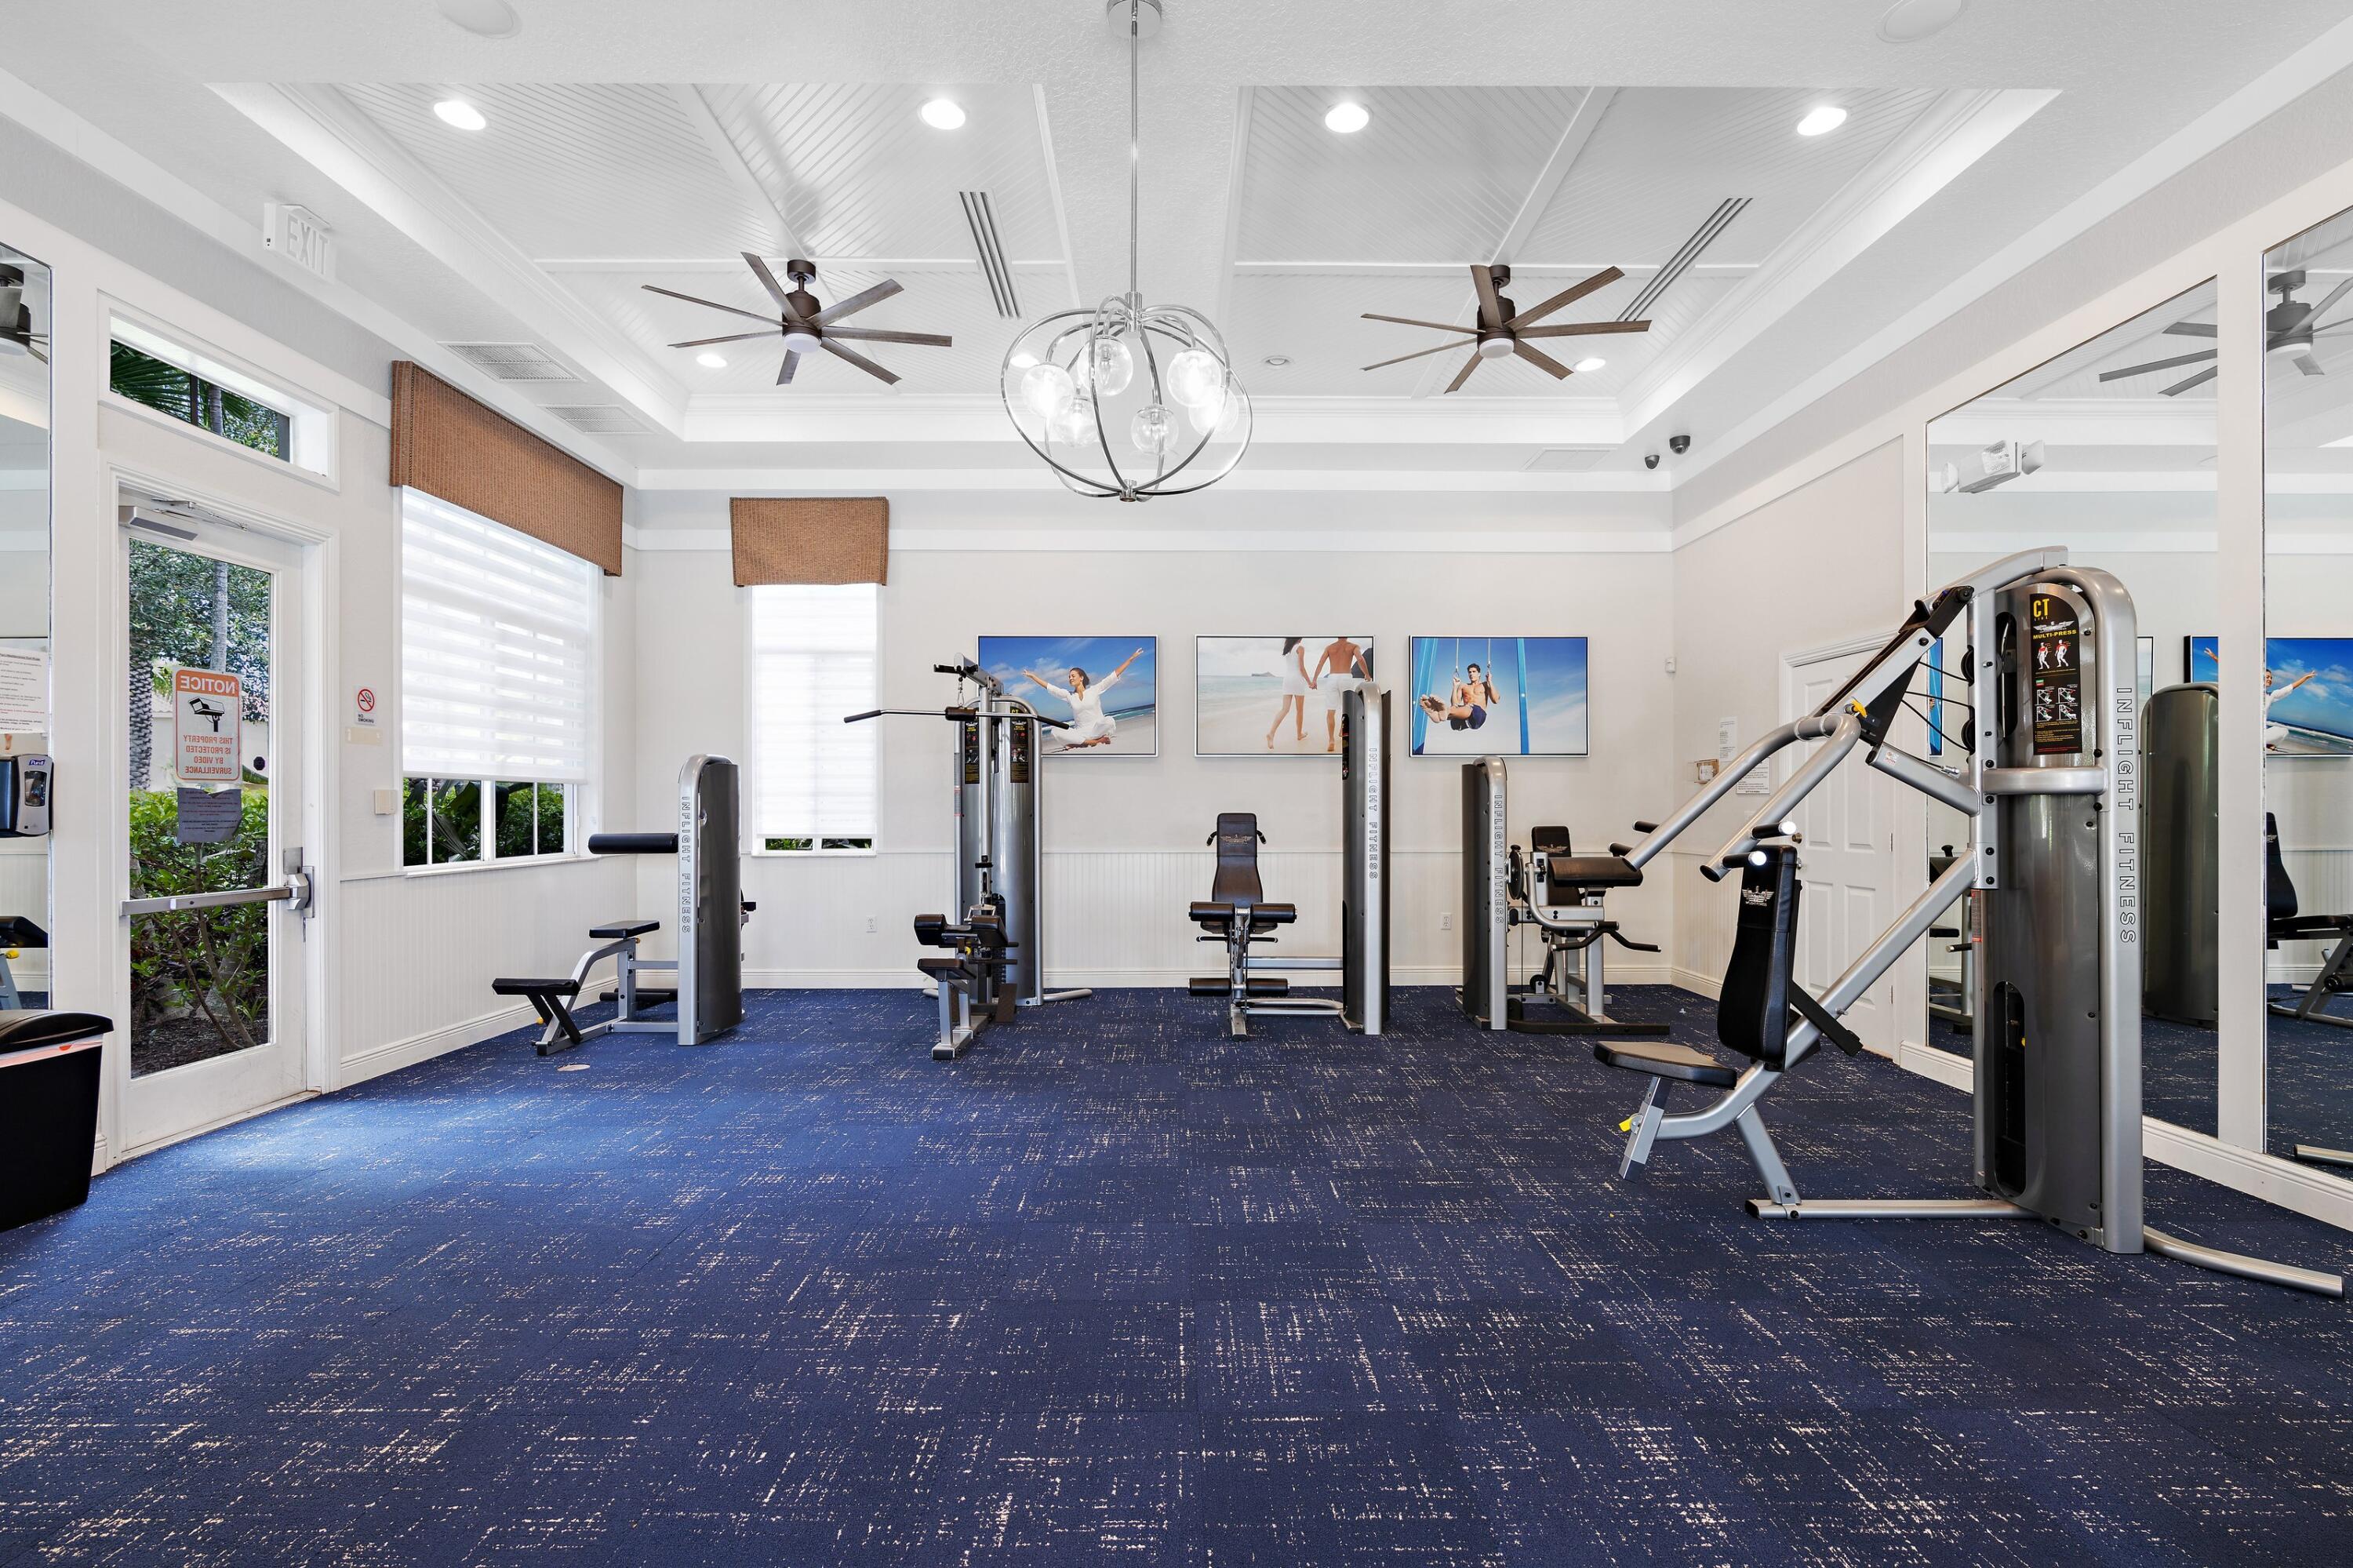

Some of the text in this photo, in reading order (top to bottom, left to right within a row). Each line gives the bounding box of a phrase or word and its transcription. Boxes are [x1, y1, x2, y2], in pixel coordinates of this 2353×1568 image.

[287, 213, 329, 275] EXIT
[2033, 598, 2049, 617] CT
[2033, 629, 2077, 639] MULTI-PRESS
[682, 796, 691, 933] INFLIGHT FITNESS
[1369, 748, 1378, 879] INFLIGHT FITNESS
[1494, 795, 1504, 924] INFLIGHT FITNESS
[2117, 688, 2137, 943] INFLIGHT FITNESS
